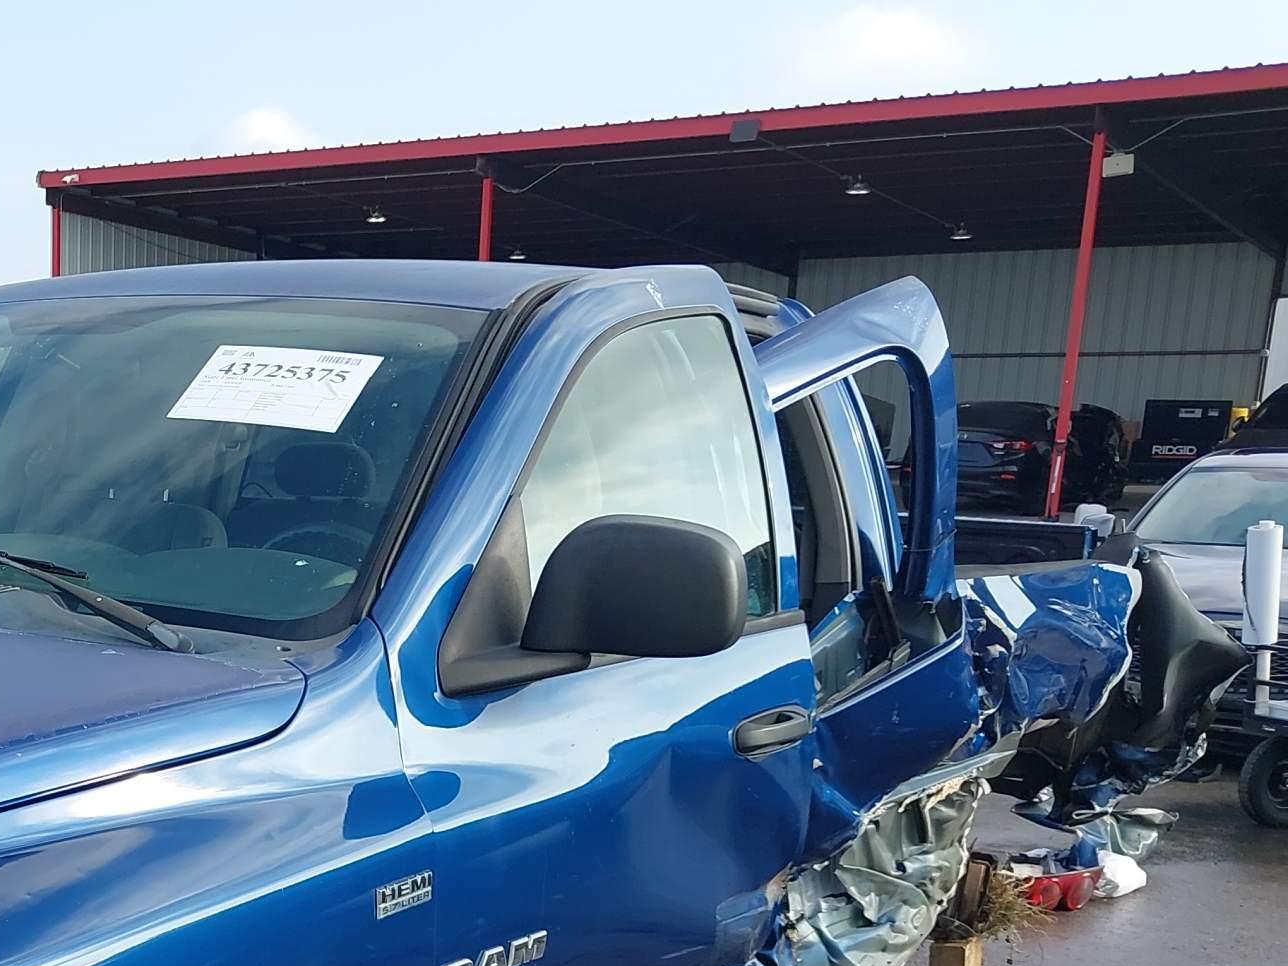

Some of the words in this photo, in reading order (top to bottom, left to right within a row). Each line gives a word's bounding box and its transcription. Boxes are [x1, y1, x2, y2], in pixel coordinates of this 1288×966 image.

[218, 361, 352, 384] 43725375
[1152, 445, 1197, 455] RIDGID
[381, 873, 432, 904] HEMI
[401, 891, 430, 907] LITER
